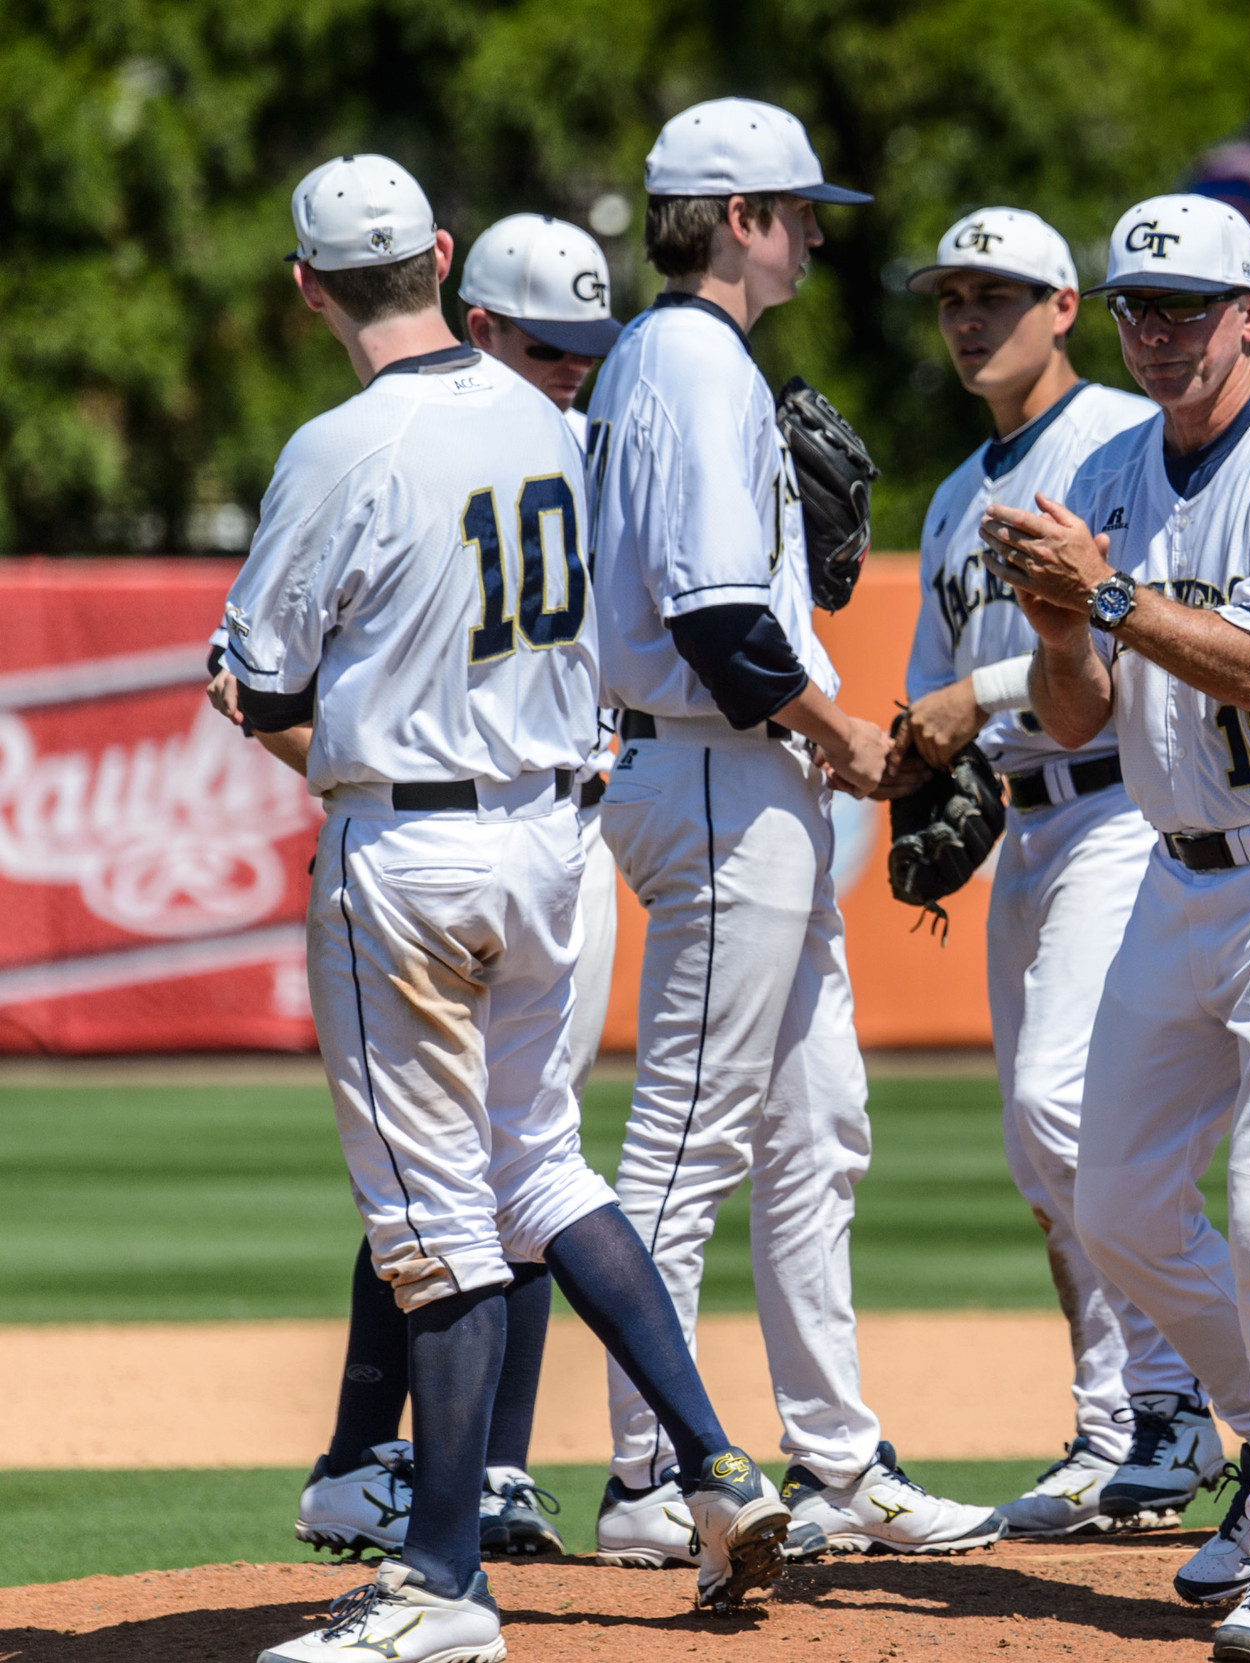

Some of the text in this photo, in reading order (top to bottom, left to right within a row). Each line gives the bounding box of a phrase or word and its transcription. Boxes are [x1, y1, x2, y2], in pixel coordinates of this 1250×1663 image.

[954, 222, 1004, 254] GT
[1124, 220, 1181, 259] GT
[571, 269, 607, 308] GT
[460, 471, 587, 666] 10
[932, 546, 1020, 652] JACK
